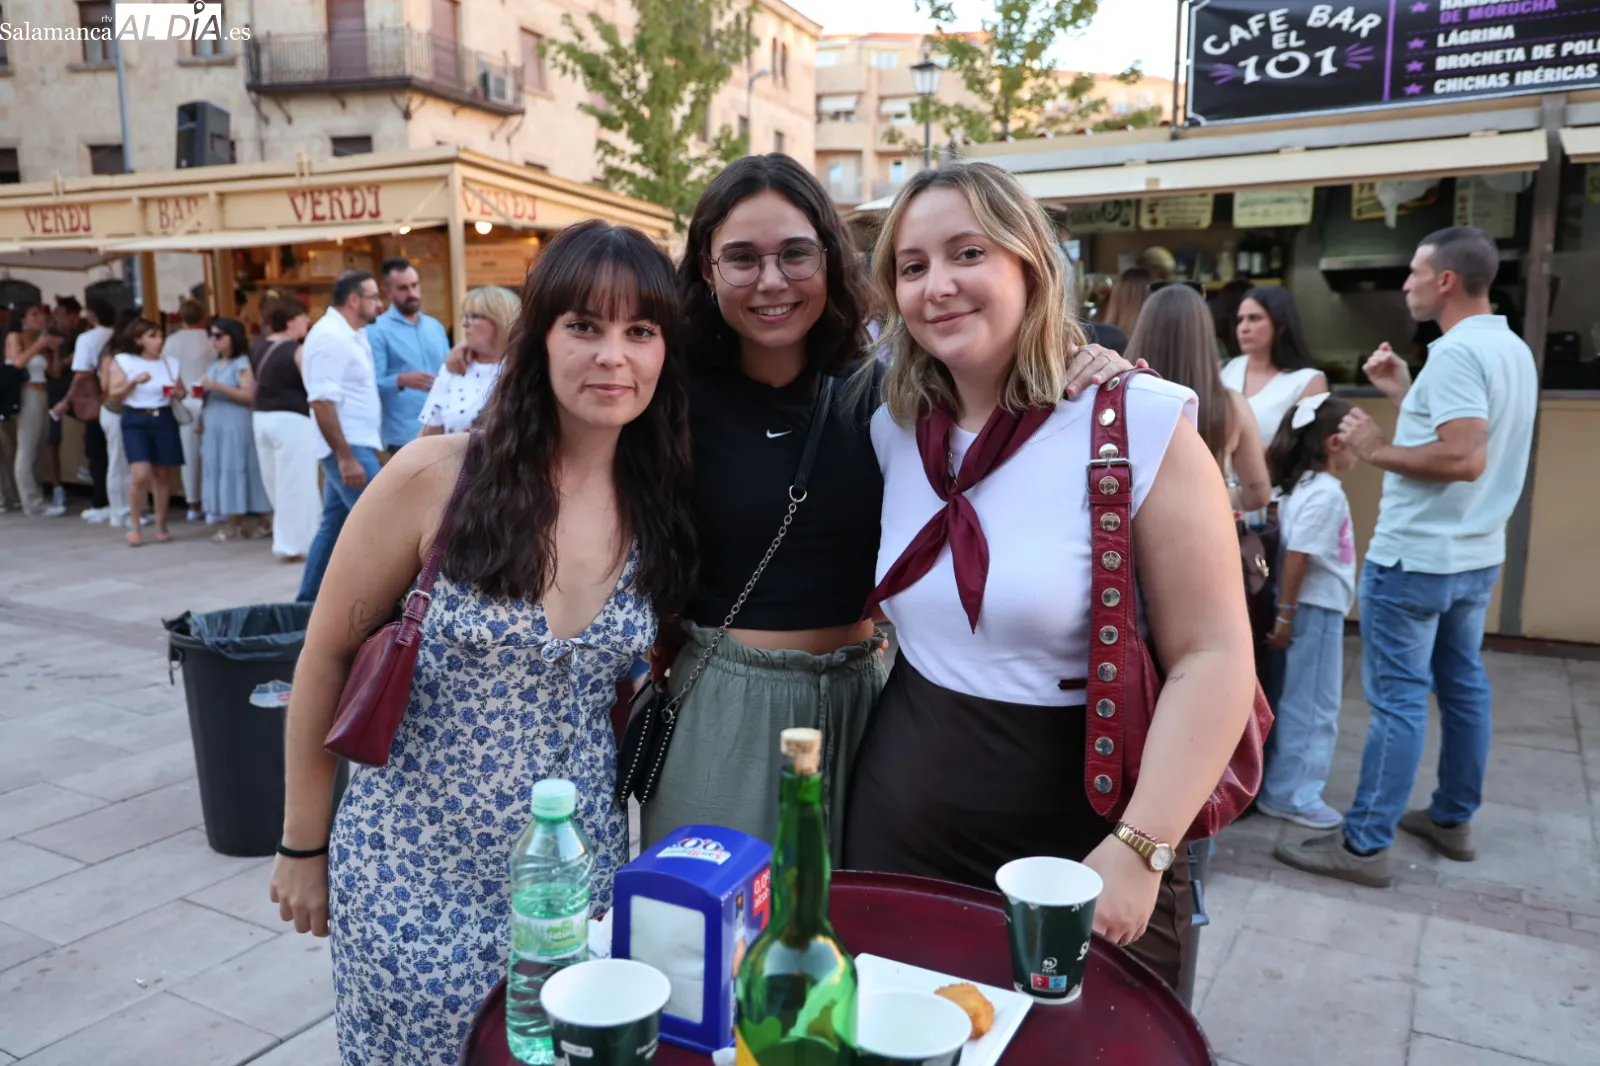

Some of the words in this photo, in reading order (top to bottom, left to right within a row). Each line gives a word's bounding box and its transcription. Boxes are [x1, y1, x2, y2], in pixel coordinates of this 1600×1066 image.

[1439, 9, 1462, 24] DE
[1467, 0, 1557, 21] MORUCHA
[1202, 8, 1289, 55] CAFE
[1306, 4, 1382, 38] BAR
[1271, 30, 1306, 49] EL
[1436, 25, 1515, 48] LÁGRIMA
[1237, 46, 1338, 84] 101
[1435, 47, 1526, 71] BROCHETA
[1531, 43, 1556, 60] DE
[1433, 72, 1510, 94] CHICHAS
[1514, 63, 1599, 86] IBÉRICAS
